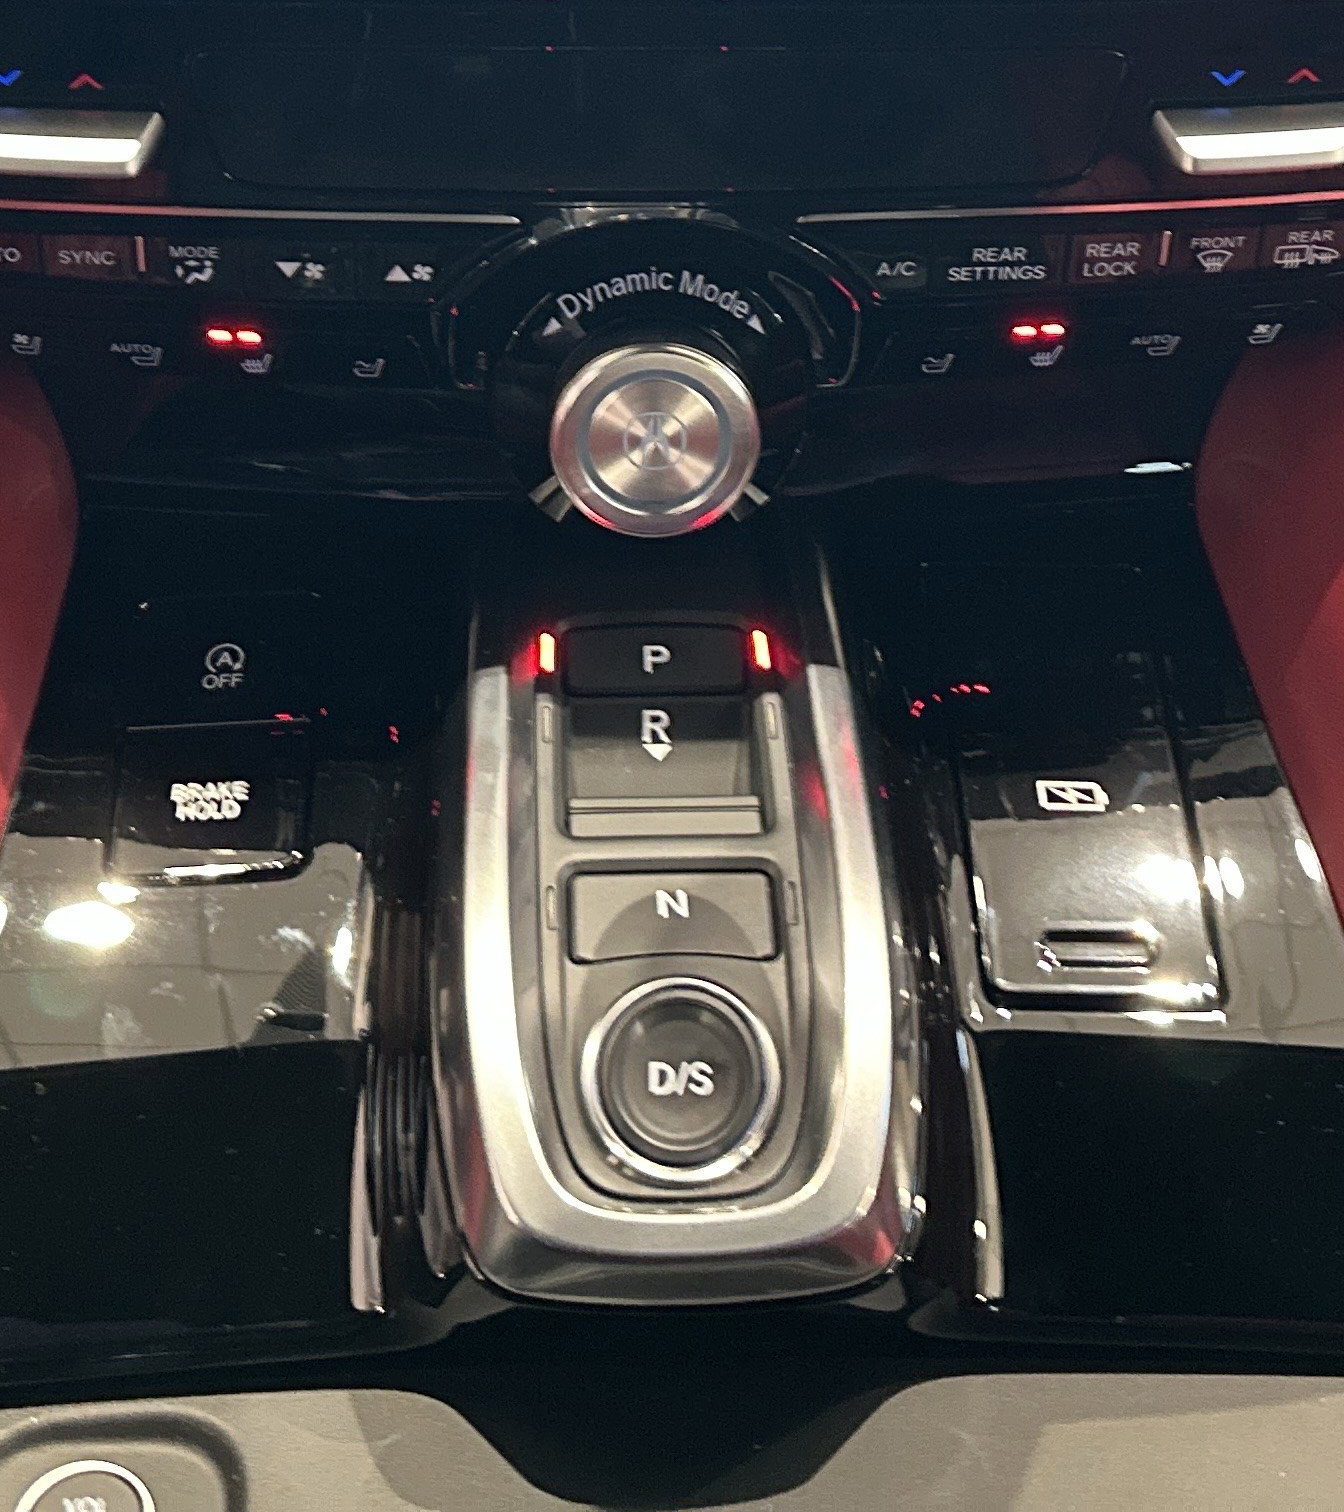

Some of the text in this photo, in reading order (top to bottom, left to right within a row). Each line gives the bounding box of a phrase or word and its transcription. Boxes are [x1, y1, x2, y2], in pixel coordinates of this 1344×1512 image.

[1190, 235, 1246, 250] FRONT
[1287, 230, 1334, 245] REAR
[57, 248, 115, 266] SYNC
[169, 245, 219, 259] MODE
[971, 246, 1028, 264] REAR
[1085, 242, 1139, 259] REAR
[877, 260, 916, 279] A/C
[947, 264, 1047, 283] SETTINGS
[1082, 260, 1139, 278] LOCK
[556, 265, 750, 319] Dynamic Mode
[110, 343, 154, 354] AUTO
[642, 645, 672, 674] P
[202, 672, 245, 689] OFF
[641, 708, 672, 744] R
[170, 780, 250, 801] BRAKE
[175, 799, 242, 822] HOLD
[655, 889, 690, 920] N
[647, 1061, 715, 1096] D/S
